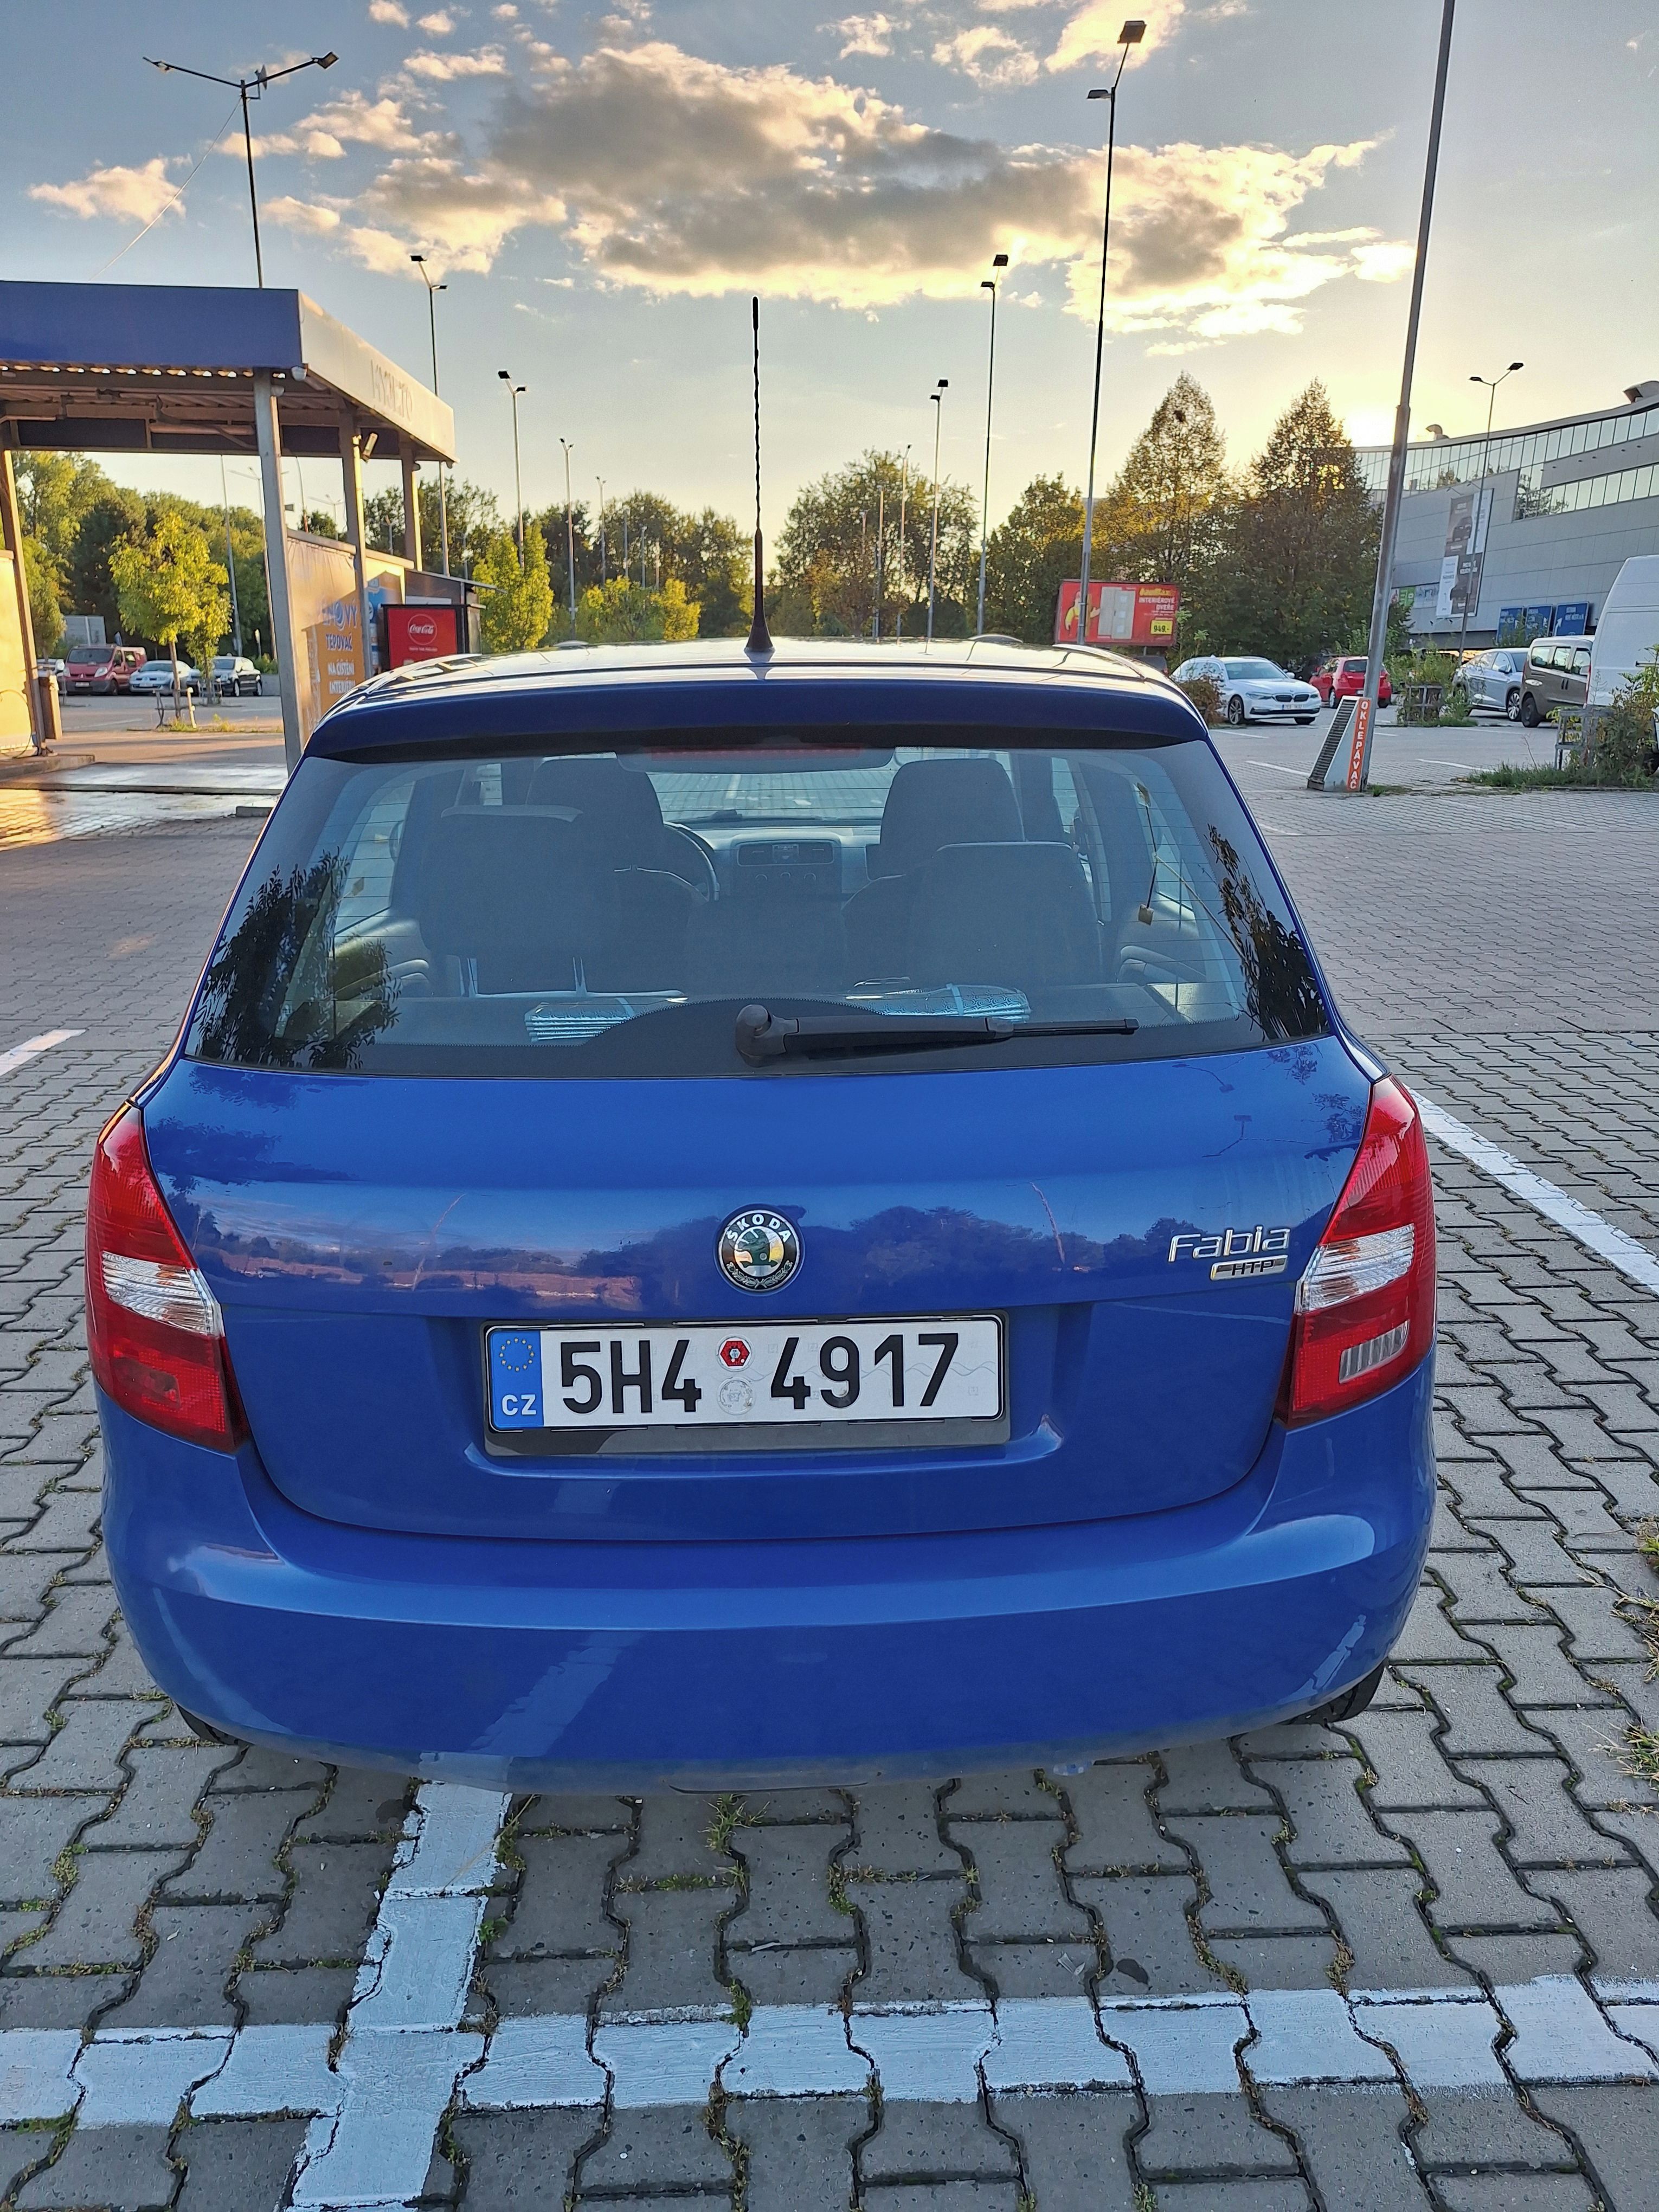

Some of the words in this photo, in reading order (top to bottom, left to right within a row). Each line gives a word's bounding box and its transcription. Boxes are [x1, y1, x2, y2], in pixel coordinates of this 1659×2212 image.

[325, 632, 353, 651] TEPOVAČ
[1168, 1225, 1291, 1263] Fabia
[1231, 1259, 1275, 1276] HTP
[500, 1394, 538, 1417] CZ
[560, 1338, 703, 1414] 5H4
[769, 1332, 960, 1411] 4917
